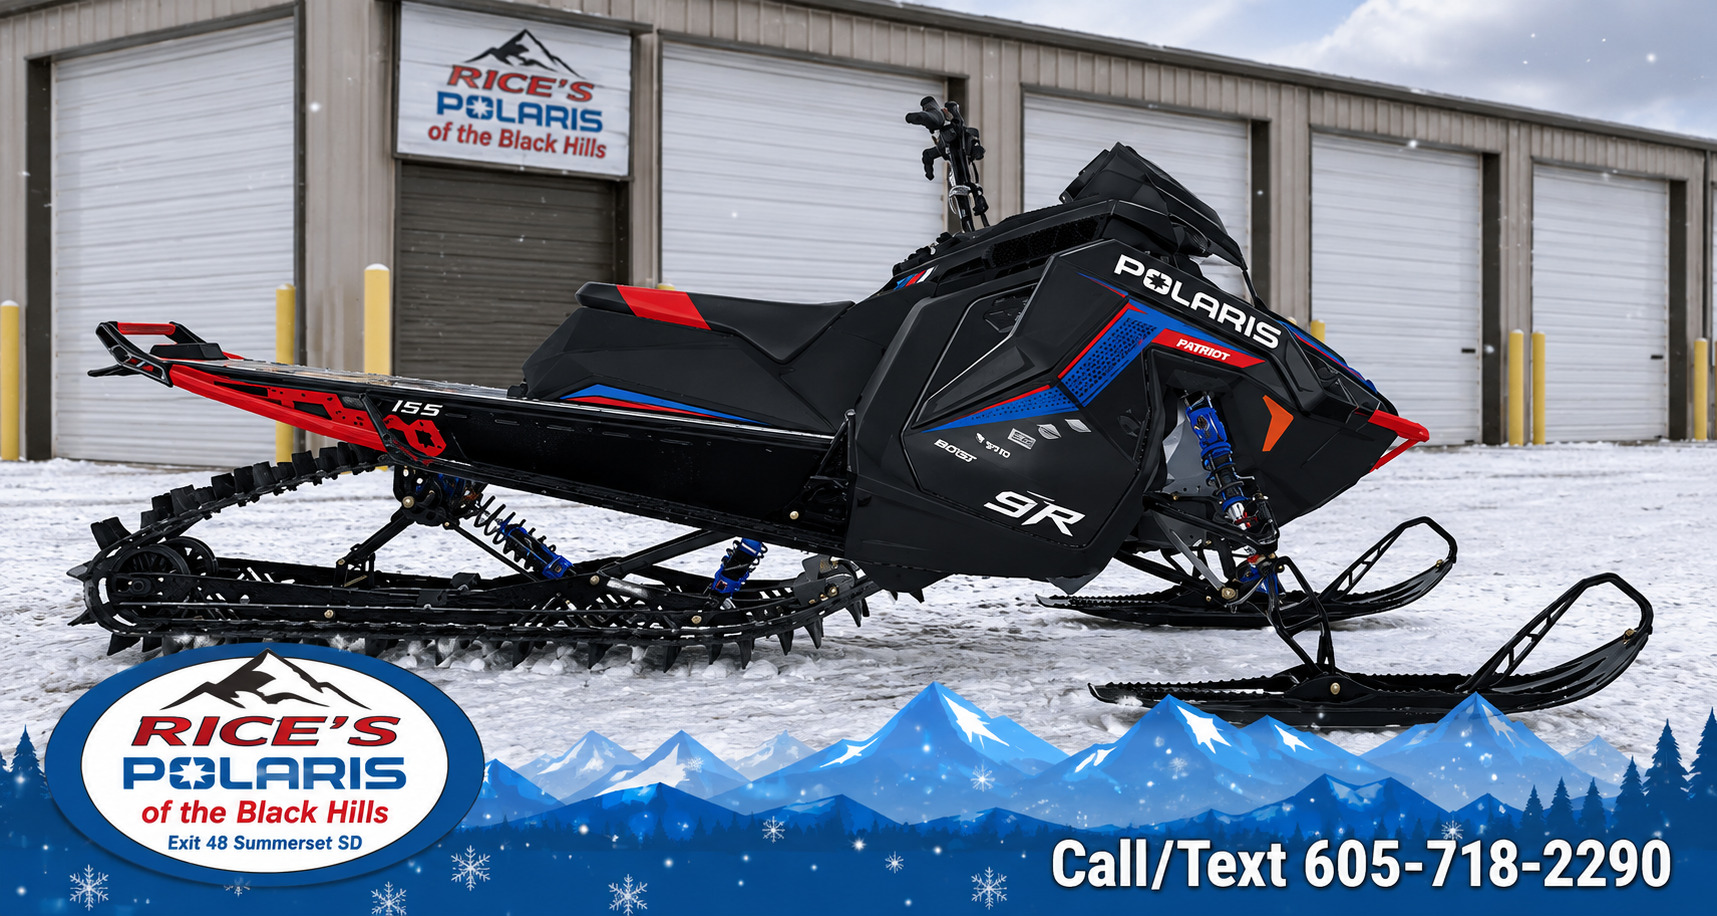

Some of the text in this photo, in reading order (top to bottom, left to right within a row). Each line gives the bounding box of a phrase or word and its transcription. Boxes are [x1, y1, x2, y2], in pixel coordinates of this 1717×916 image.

[447, 65, 595, 102] RICE'S
[436, 91, 603, 133] POLARIS
[428, 122, 607, 159] of the Black Hills
[1114, 254, 1282, 349] POLARIS
[1176, 338, 1231, 361] PATRIOT
[391, 400, 444, 417] 155
